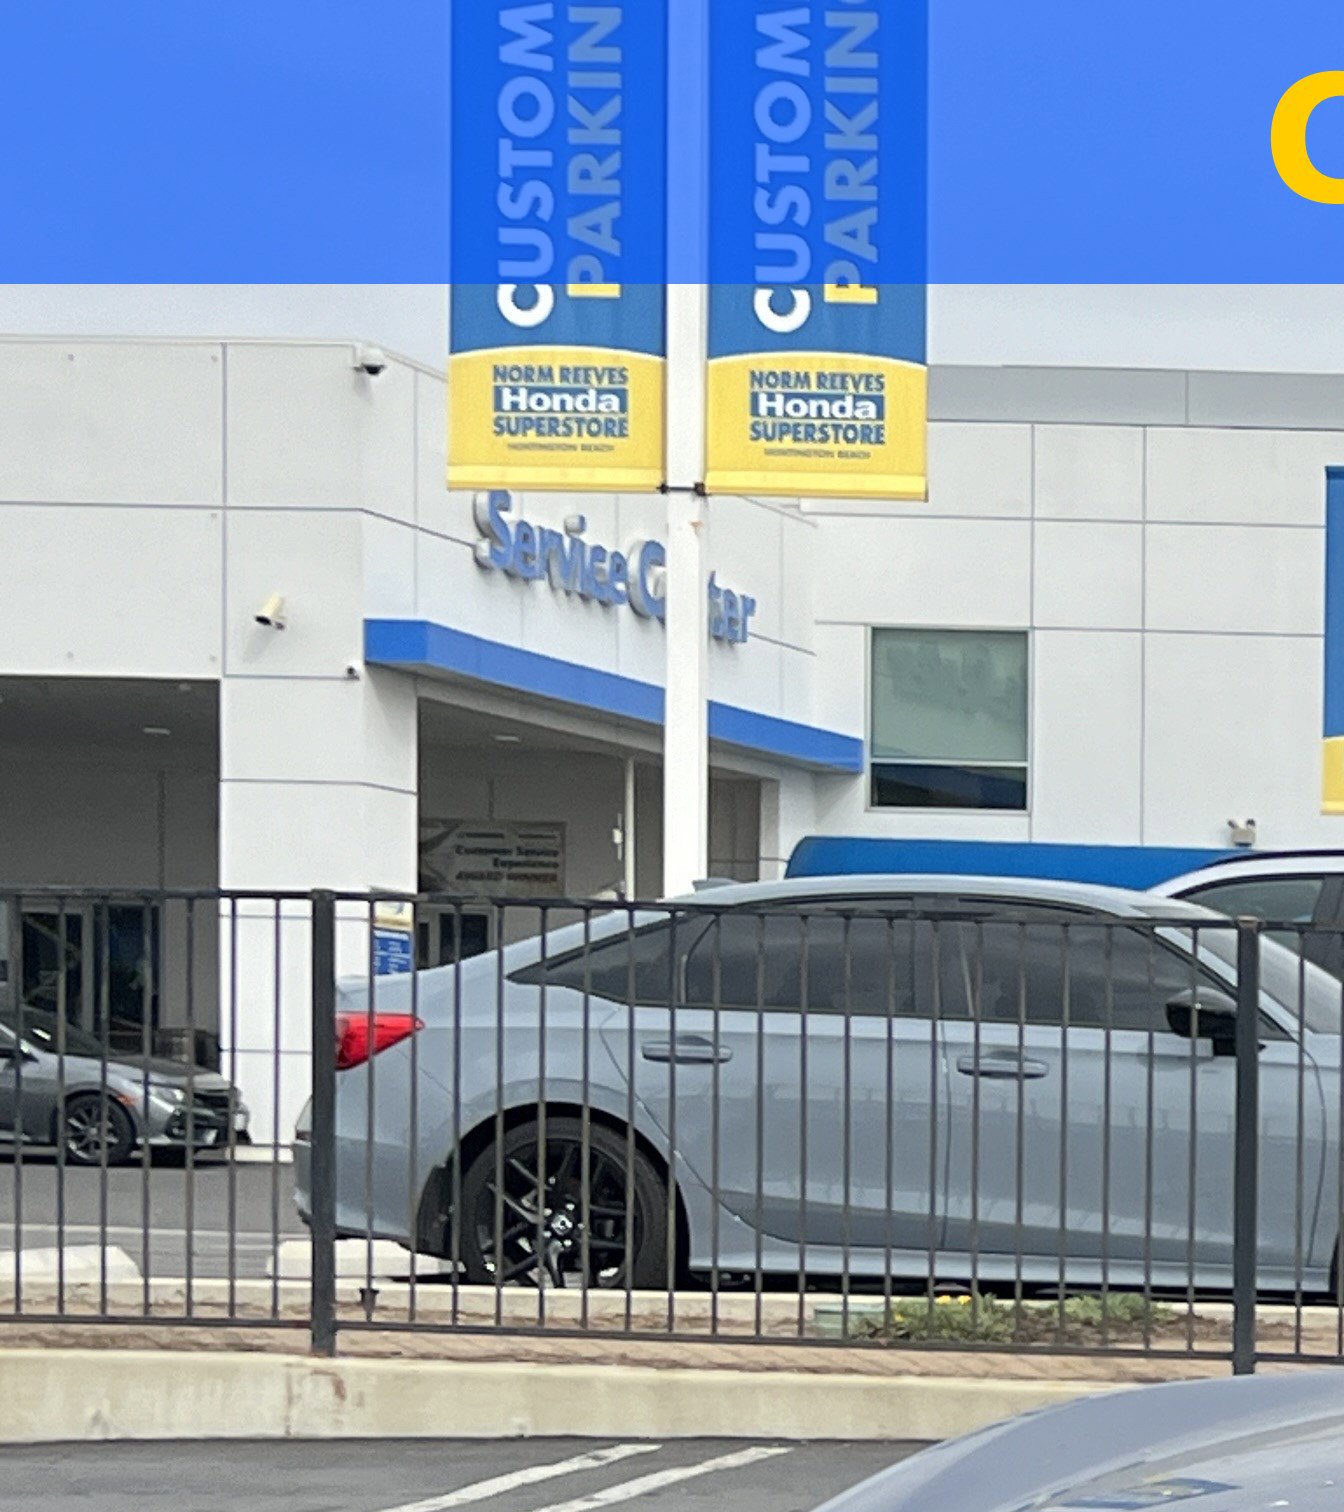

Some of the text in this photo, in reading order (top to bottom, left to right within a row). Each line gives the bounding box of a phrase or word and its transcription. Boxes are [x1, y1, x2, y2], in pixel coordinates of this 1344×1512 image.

[824, 0, 880, 305] PARKIN
[753, 0, 812, 334] CUSTOM
[493, 364, 629, 385] NORM REEVES
[750, 369, 885, 392] NORM REEVES
[501, 386, 620, 412] Honda
[758, 392, 877, 419] Honda
[493, 415, 629, 438] SUPERSTORE
[750, 421, 885, 445] SUPERSTORE
[474, 490, 757, 644] Service Cter
